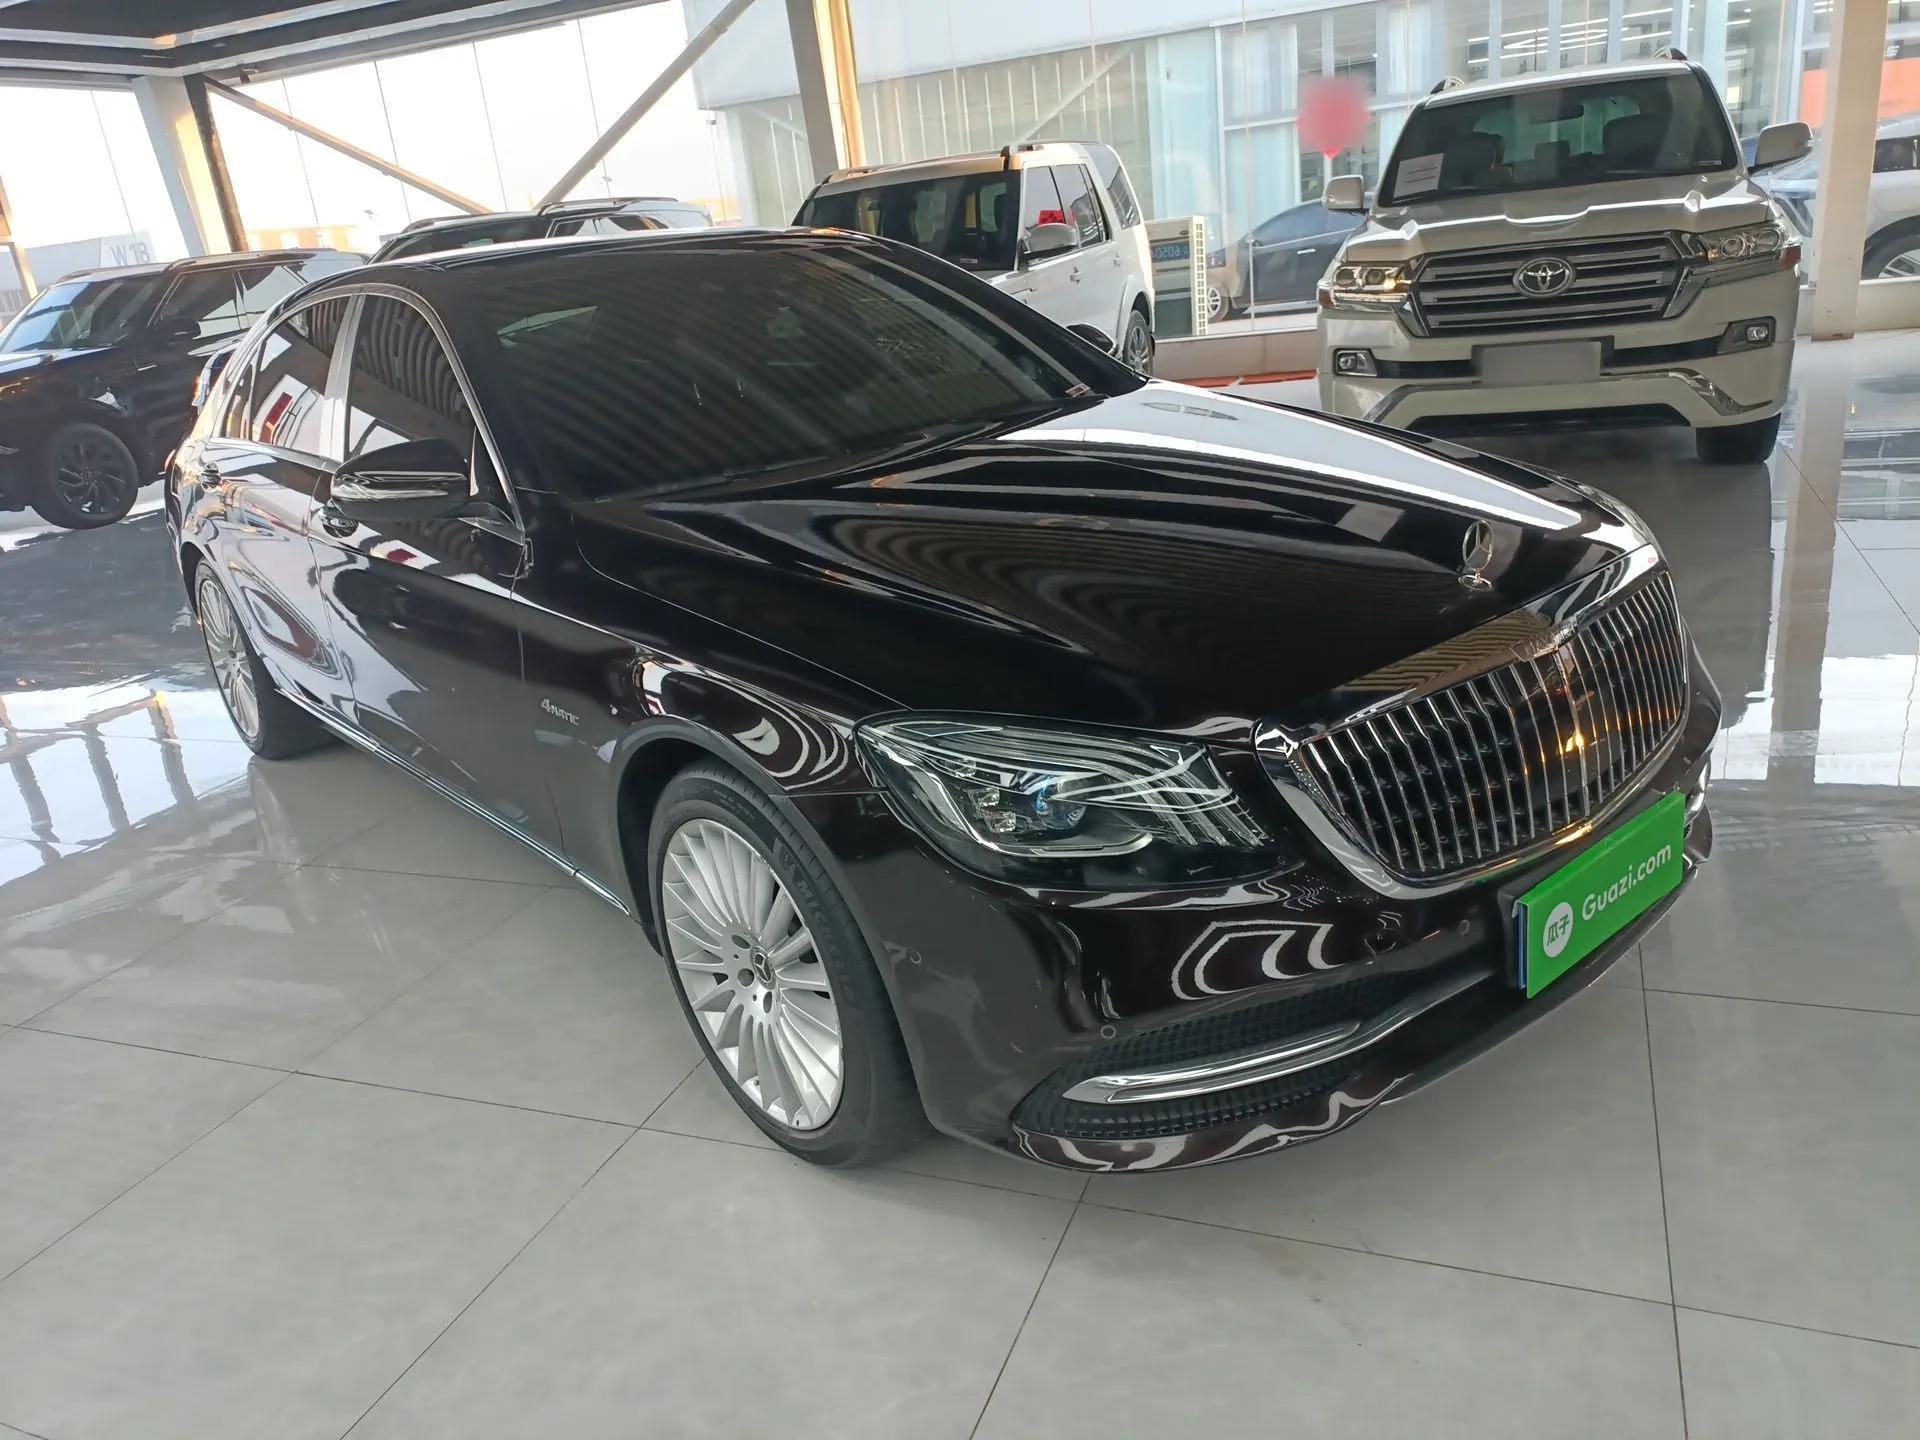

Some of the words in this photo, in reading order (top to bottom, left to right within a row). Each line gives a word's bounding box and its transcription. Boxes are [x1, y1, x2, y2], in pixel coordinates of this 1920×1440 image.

[540, 698, 579, 726] 4MATIC
[1546, 912, 1571, 947] 瓜子
[1581, 844, 1672, 921] Guazi.com
